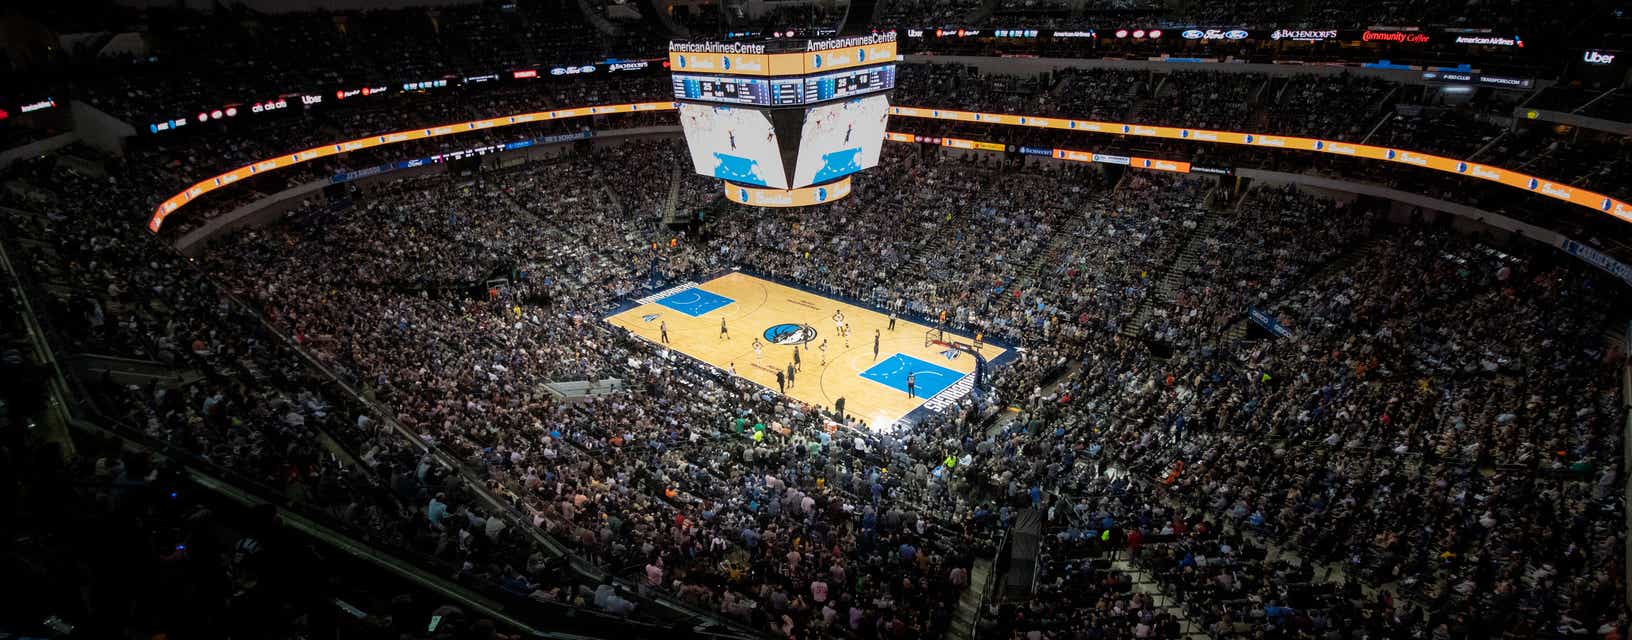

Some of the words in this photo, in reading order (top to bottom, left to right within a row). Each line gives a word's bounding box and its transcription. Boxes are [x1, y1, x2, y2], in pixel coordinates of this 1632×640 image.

[1362, 30, 1407, 43] Community
[1407, 33, 1430, 44] Coffee
[1456, 36, 1488, 45] American
[1488, 37, 1514, 46] Airlines
[1584, 51, 1615, 64] Uber
[301, 95, 322, 104] Uber
[407, 159, 423, 169] Ford
